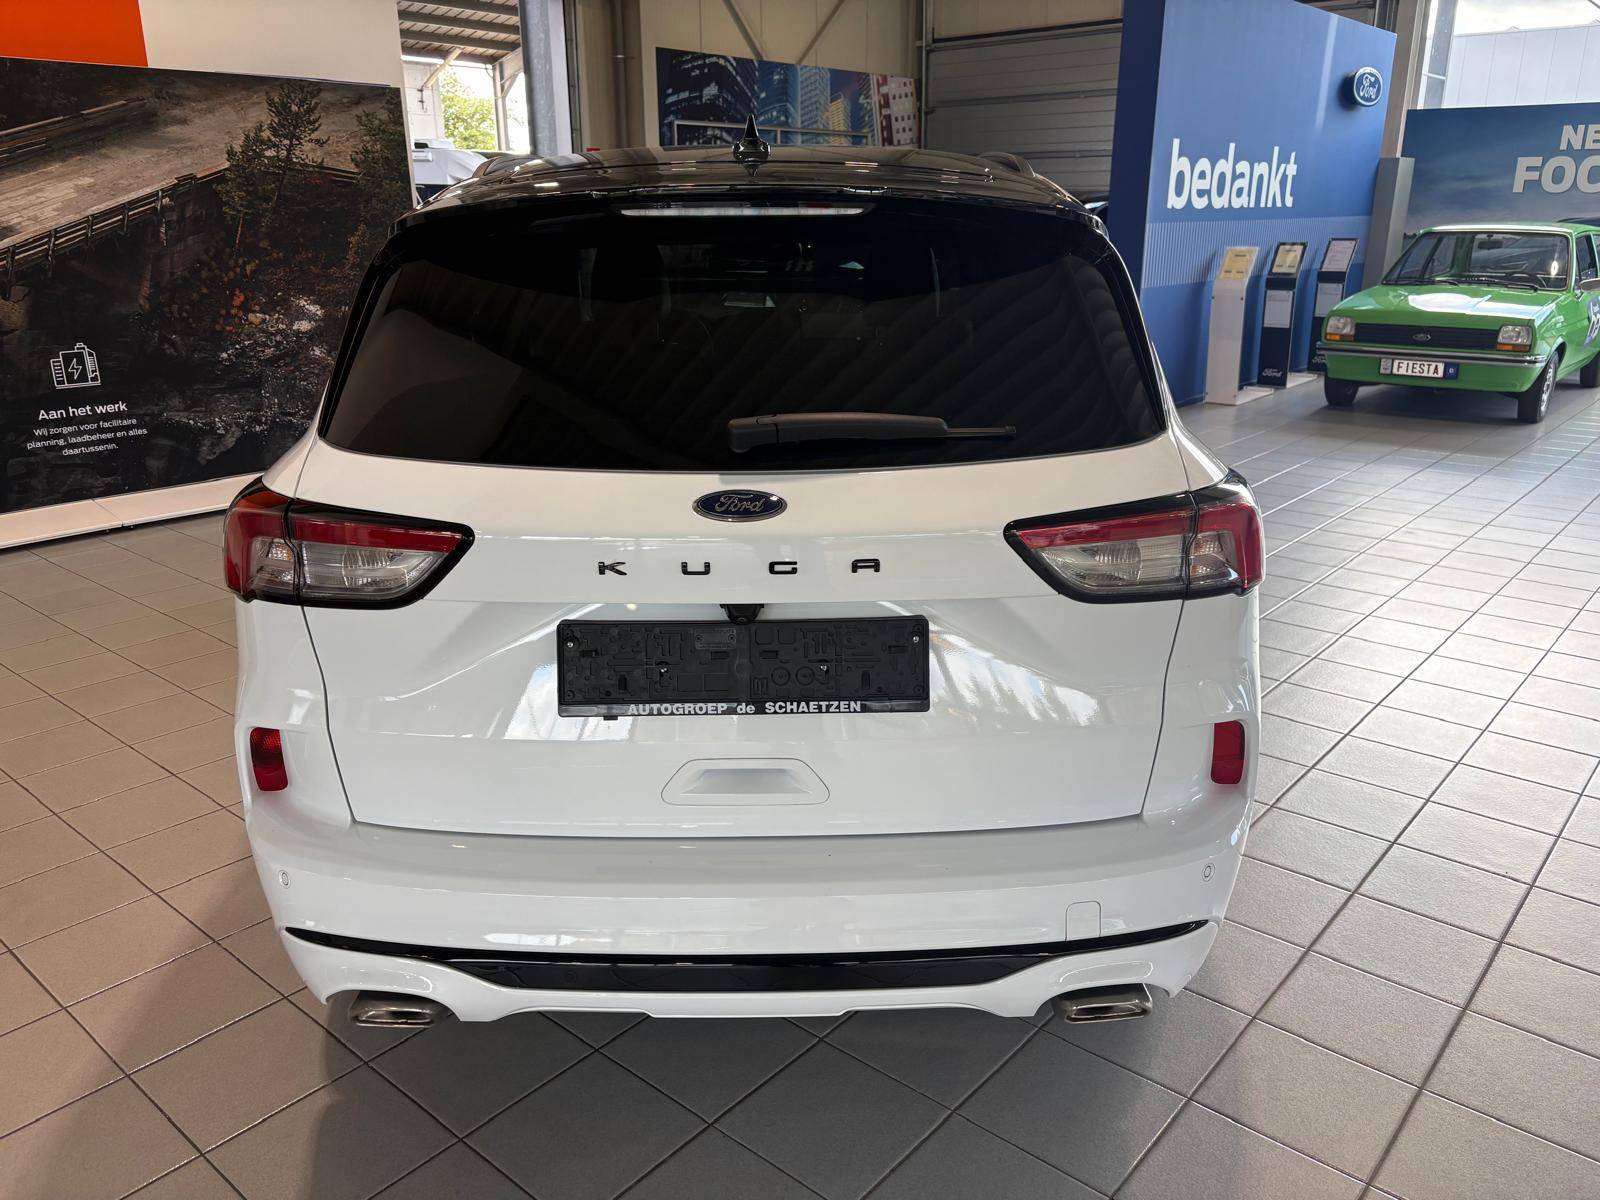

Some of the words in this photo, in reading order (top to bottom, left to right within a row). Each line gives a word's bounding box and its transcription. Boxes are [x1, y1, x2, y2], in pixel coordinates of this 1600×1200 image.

[1359, 73, 1379, 99] Ford
[1166, 138, 1298, 210] bedankt
[1396, 361, 1440, 376] FIESTA
[38, 409, 67, 420] Aan
[68, 405, 93, 417] het
[95, 401, 128, 414] werk
[33, 427, 48, 437] Wij
[49, 424, 78, 435] zorgen
[79, 422, 98, 431] voor
[99, 417, 138, 428] facilitaire
[26, 438, 67, 450] planning,
[68, 431, 115, 443] laadbeheer
[116, 430, 127, 438] en
[128, 427, 148, 437] alles
[62, 442, 119, 455] daartussenin.
[714, 493, 766, 512] Ford
[597, 558, 881, 576] KUGA
[626, 702, 729, 715] AUTOGROEP
[736, 702, 756, 714] de
[764, 700, 862, 714] SCHAETZEN
